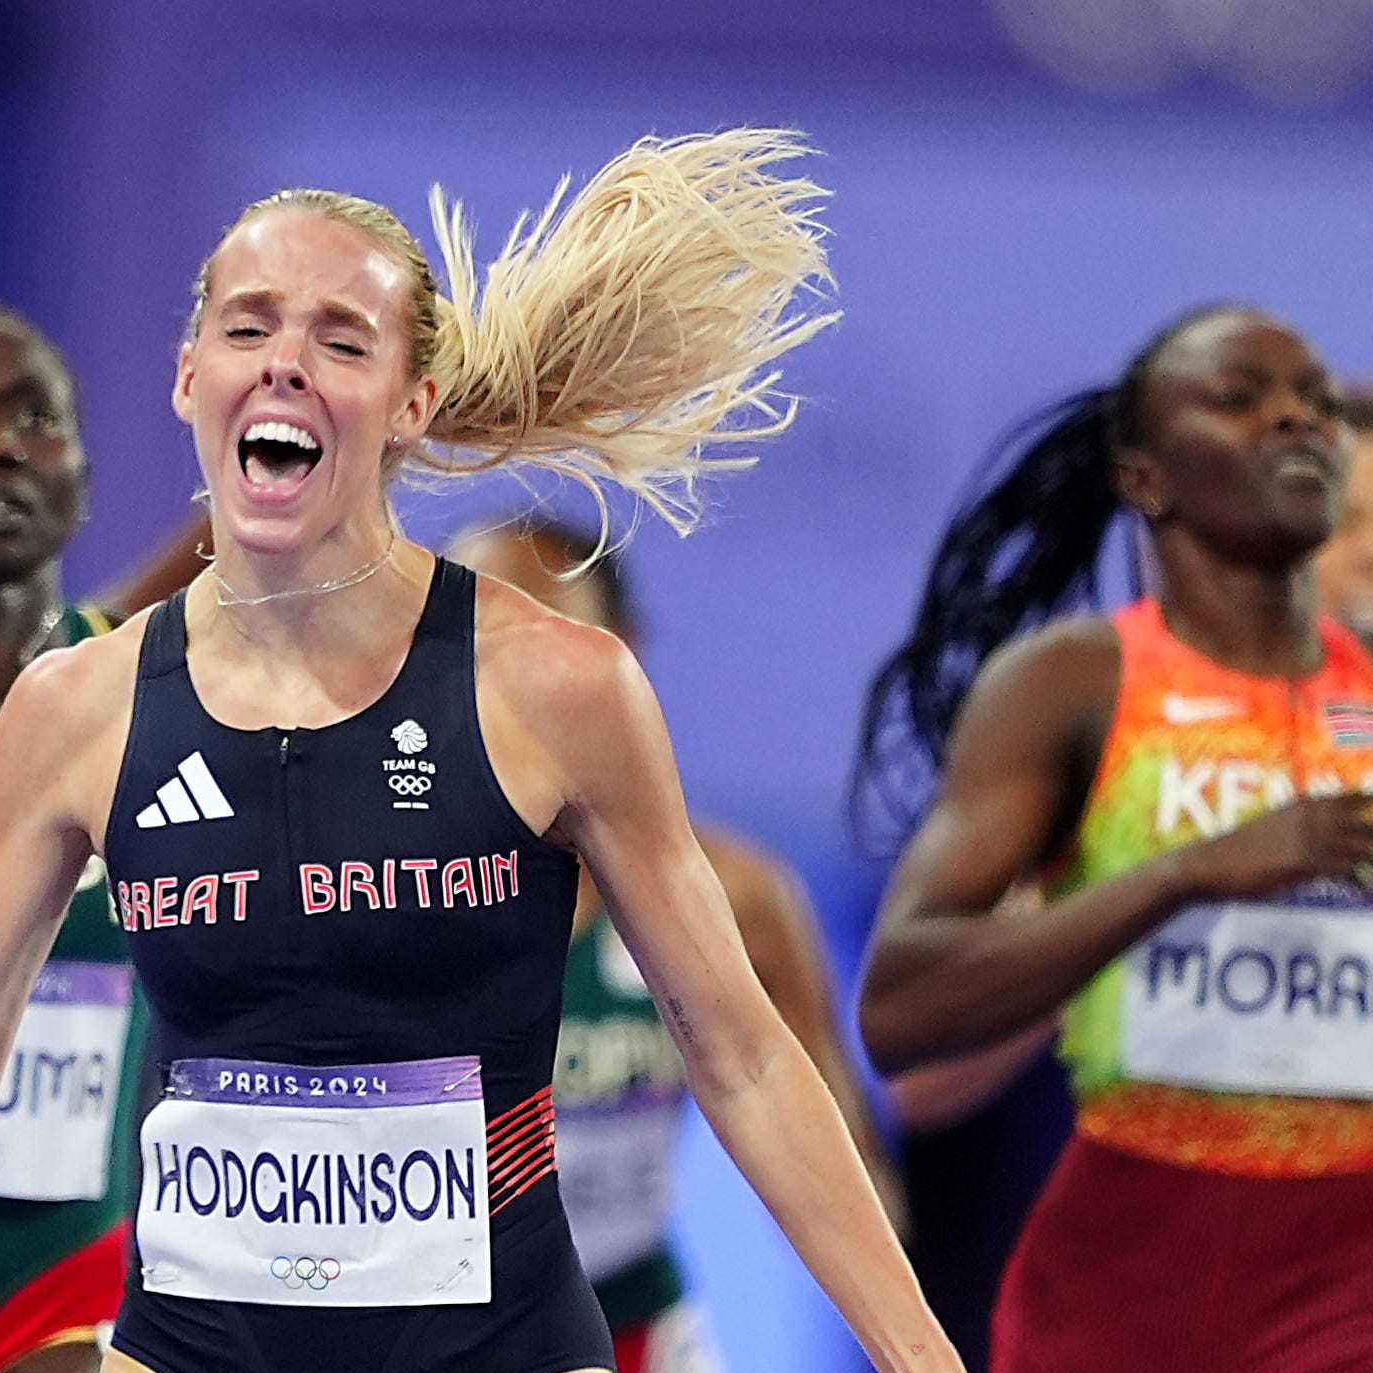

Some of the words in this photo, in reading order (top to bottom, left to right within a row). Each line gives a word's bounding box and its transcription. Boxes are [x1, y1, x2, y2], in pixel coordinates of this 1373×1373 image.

[382, 759, 416, 771] TEAM
[418, 760, 436, 774] GB
[298, 849, 519, 915] BRITAIN
[218, 1070, 299, 1095] PARIS
[309, 1075, 388, 1098] 2024
[152, 1141, 477, 1226] HODGKINSON
